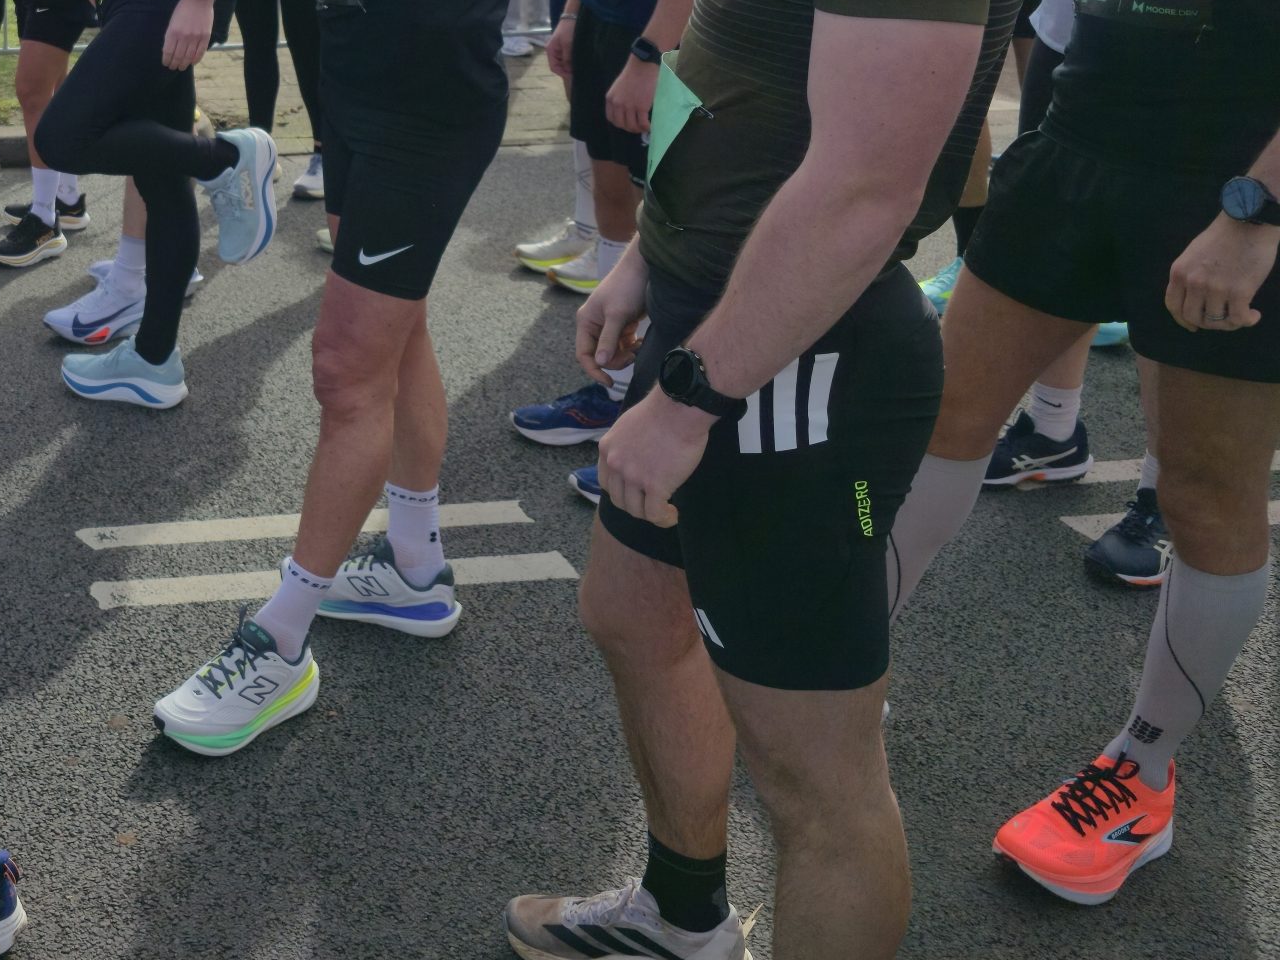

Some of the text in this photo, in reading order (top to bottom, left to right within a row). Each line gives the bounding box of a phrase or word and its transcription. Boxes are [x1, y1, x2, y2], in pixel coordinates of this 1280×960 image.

[1146, 5, 1176, 16] MOORE
[855, 480, 874, 537] ADIZERO
[1111, 825, 1131, 840] BROOKS
